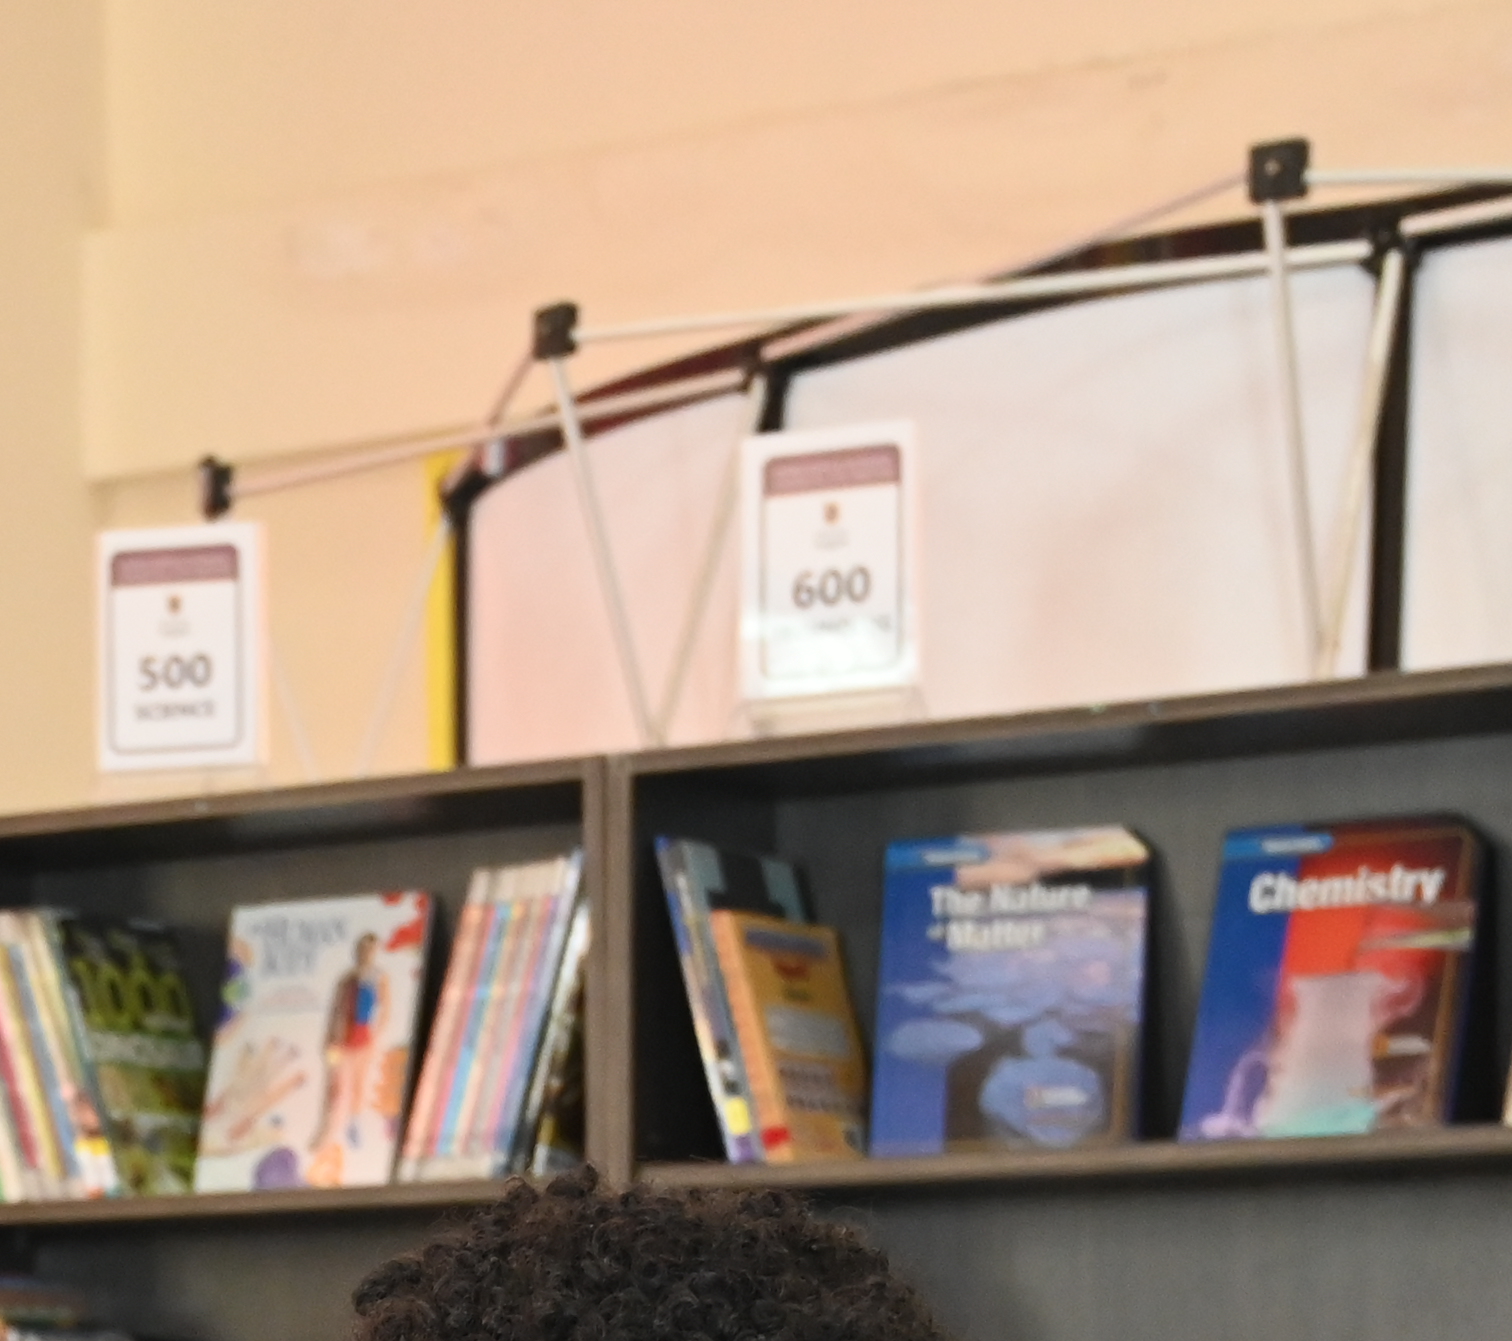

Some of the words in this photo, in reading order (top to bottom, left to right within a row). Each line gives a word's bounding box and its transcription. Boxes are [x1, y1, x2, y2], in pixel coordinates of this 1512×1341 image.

[791, 564, 872, 610] 600
[137, 652, 213, 692] 500
[994, 881, 1093, 914] Nature
[1247, 863, 1447, 918] Chemistry
